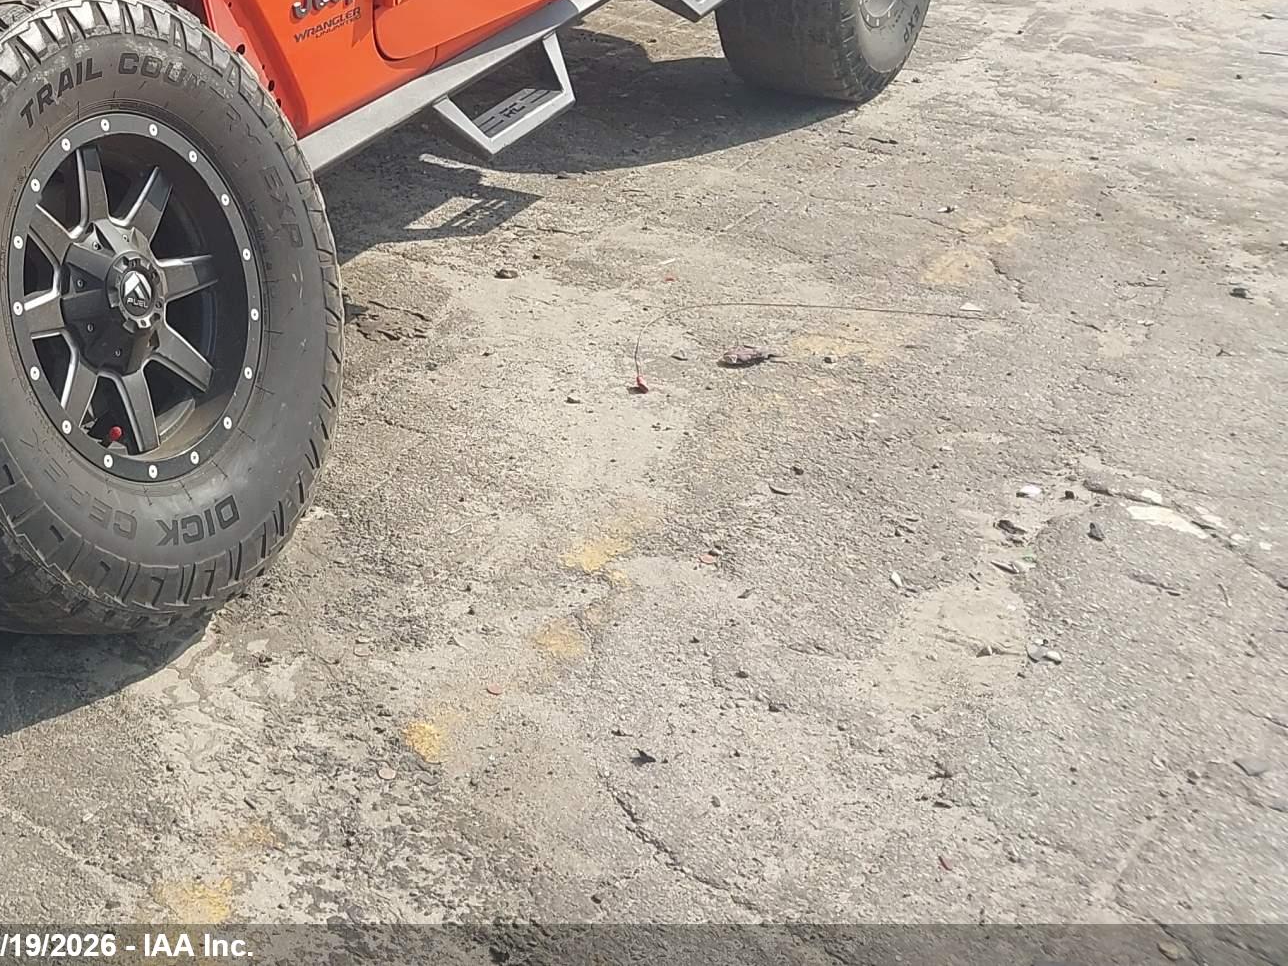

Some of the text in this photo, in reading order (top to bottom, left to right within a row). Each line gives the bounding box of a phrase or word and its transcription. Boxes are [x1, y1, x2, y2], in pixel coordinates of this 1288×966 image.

[293, 7, 361, 42] WRANGLER
[19, 57, 103, 129] TRAIL
[156, 494, 240, 546] DICK
